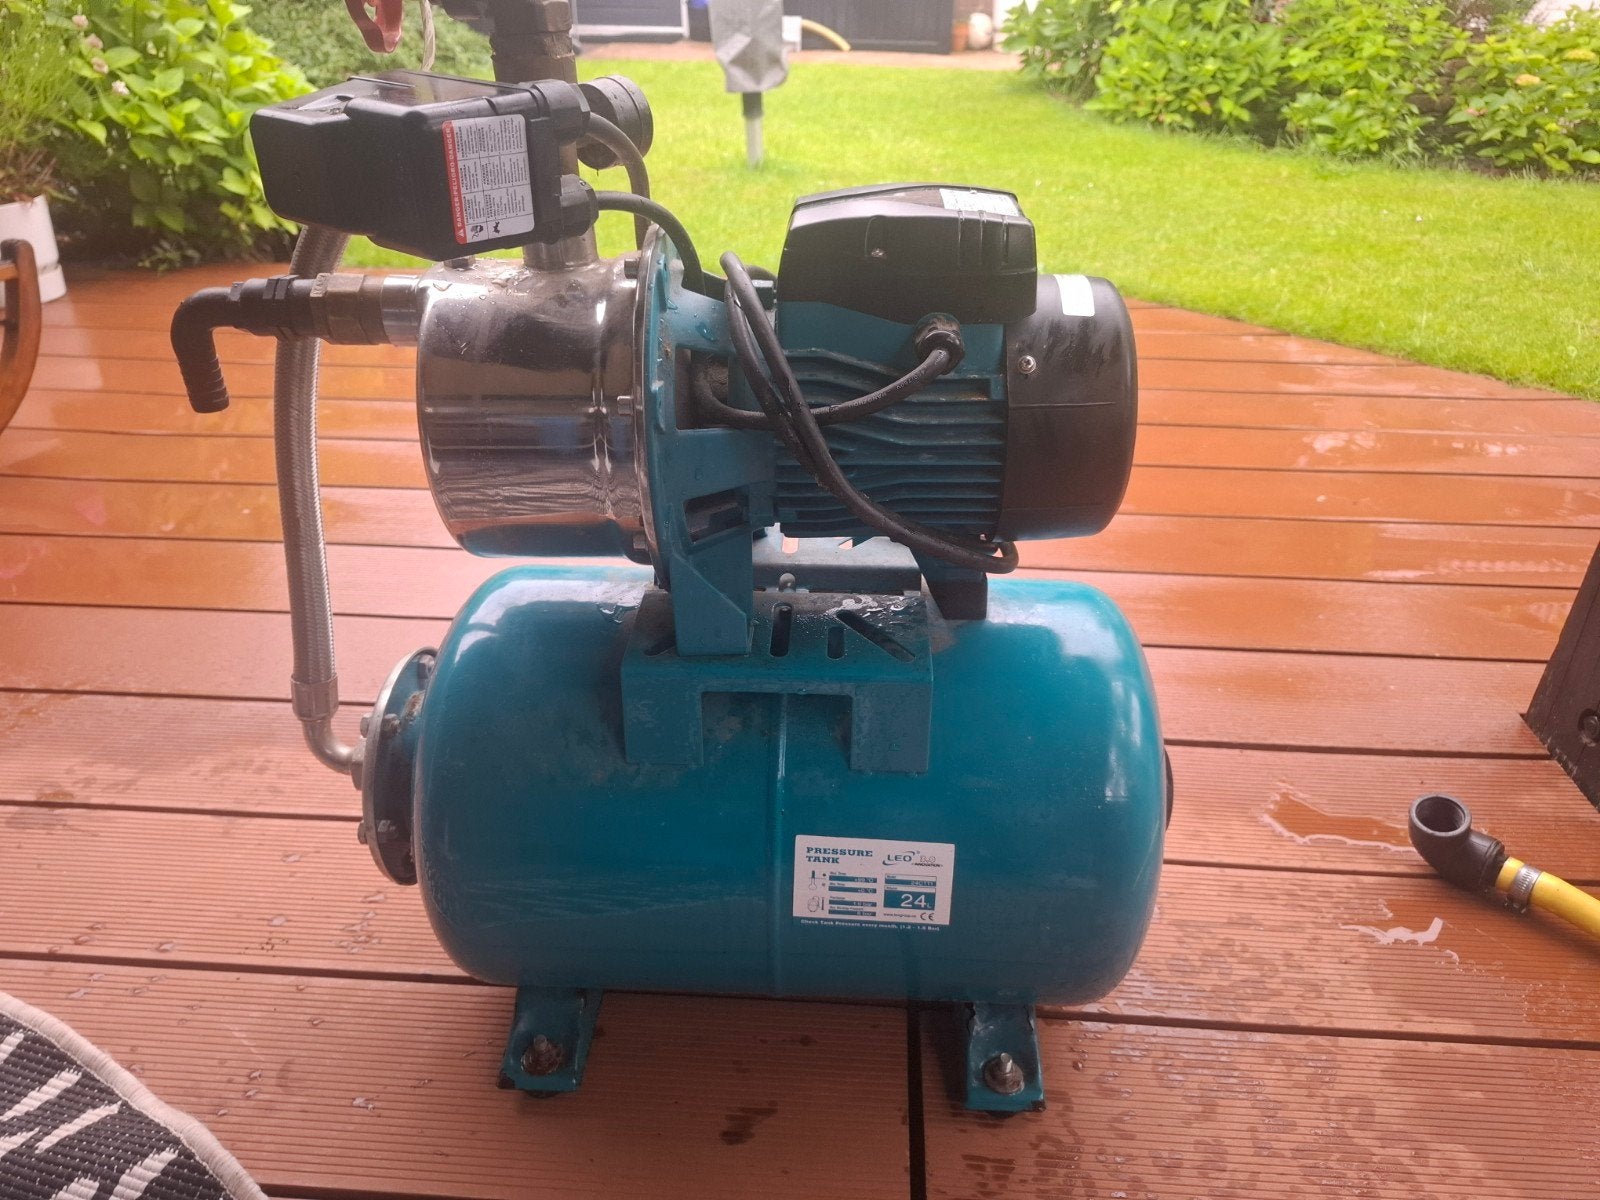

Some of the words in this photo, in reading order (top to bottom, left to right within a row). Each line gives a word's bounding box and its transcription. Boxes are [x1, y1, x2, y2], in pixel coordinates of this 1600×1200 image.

[446, 128, 454, 160] DANGER
[453, 196, 463, 227] DANGER
[806, 847, 873, 857] PRESSURE
[806, 855, 839, 864] TANK
[887, 854, 912, 862] LEO
